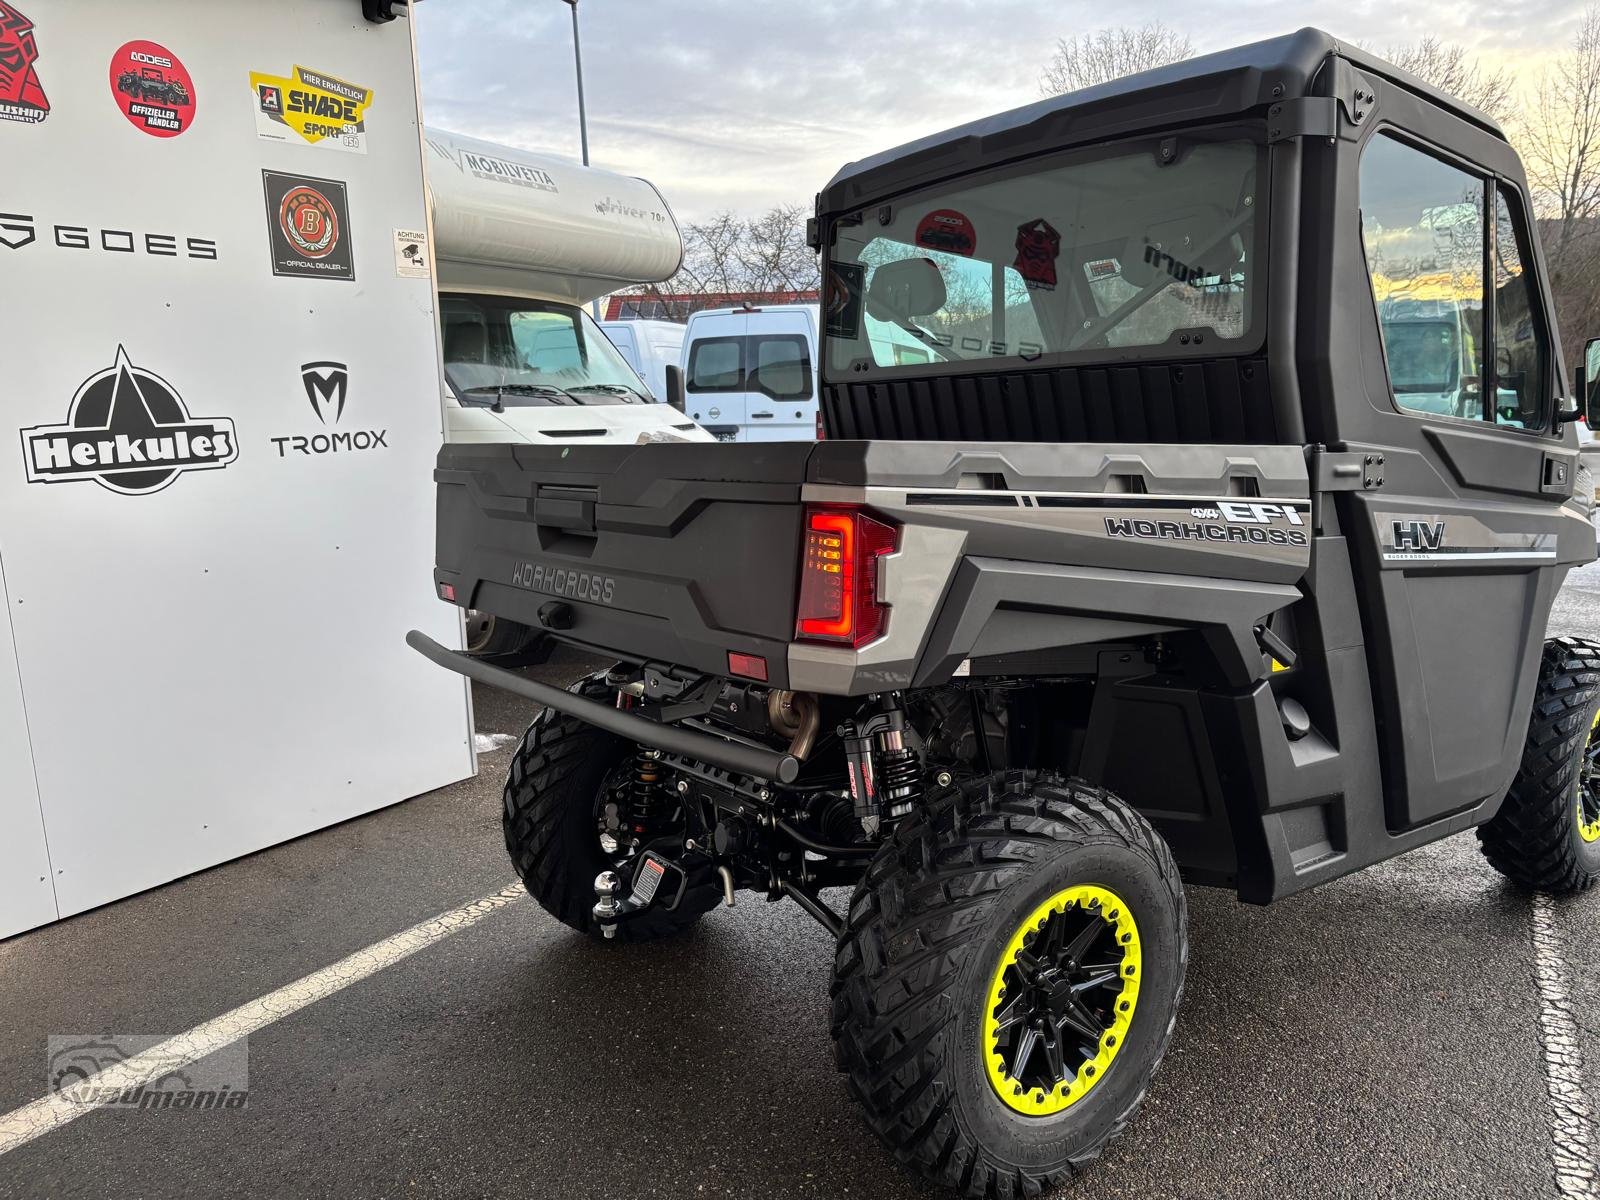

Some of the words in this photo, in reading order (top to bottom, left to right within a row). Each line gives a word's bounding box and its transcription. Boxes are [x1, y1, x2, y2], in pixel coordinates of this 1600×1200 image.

[303, 73, 321, 87] HIER
[322, 79, 363, 101] ERHÄLTLICH
[131, 104, 176, 120] OFFIZIELLER
[287, 90, 358, 122] SHADE
[147, 115, 179, 130] HÄNDLER
[342, 123, 357, 135] 650
[465, 154, 555, 186] MOBILVETTA
[53, 224, 218, 260] GOES
[398, 231, 425, 239] ACHTUNG
[286, 260, 315, 269] OFFICIAL
[315, 262, 341, 270] DEALER
[32, 430, 230, 470] Herkules
[270, 429, 388, 457] TROMOX
[1391, 520, 1445, 550] HV
